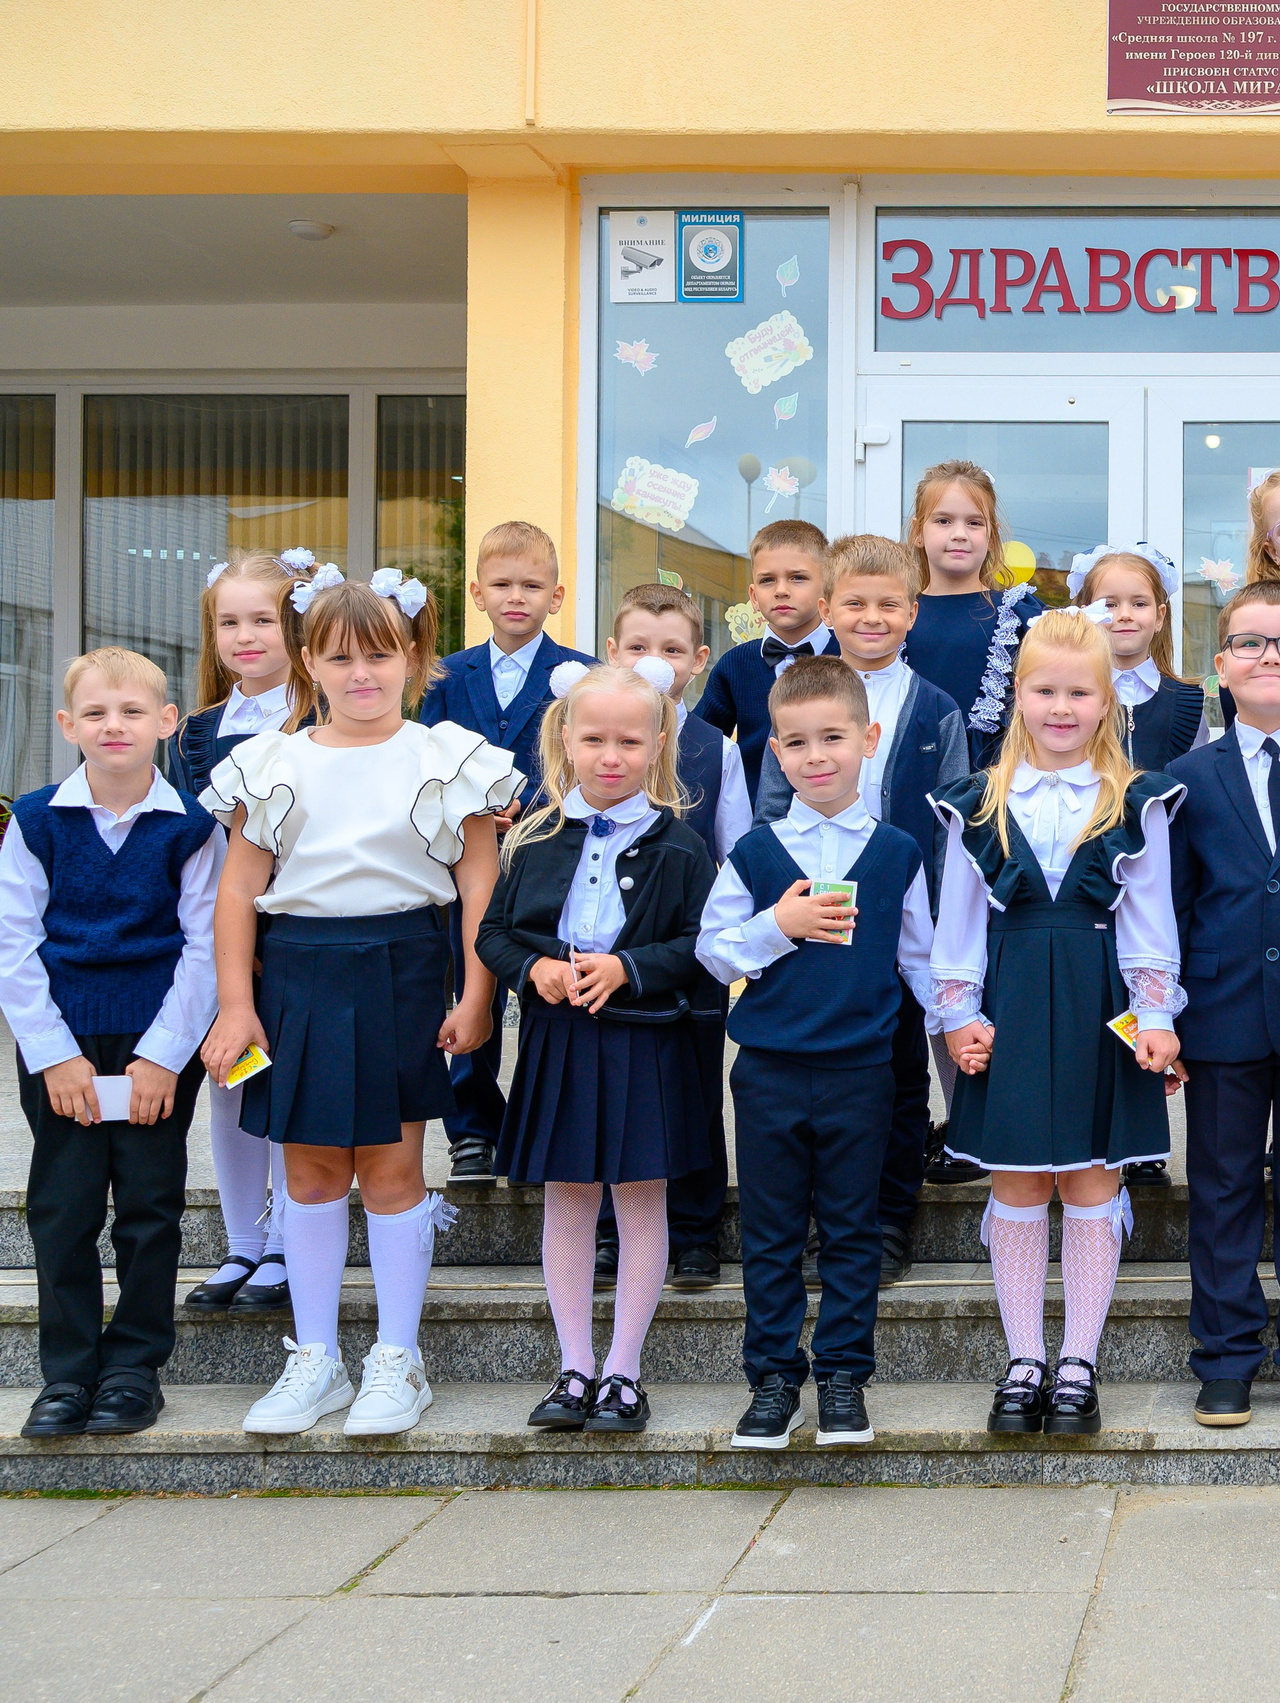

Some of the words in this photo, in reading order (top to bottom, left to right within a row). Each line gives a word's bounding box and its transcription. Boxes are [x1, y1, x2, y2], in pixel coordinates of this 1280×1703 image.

[1137, 16, 1220, 26] УЧРЕЖДЕНИЮ
[1111, 32, 1173, 45] «Средняя
[1177, 35, 1218, 43] школа
[1222, 33, 1236, 43] №
[1240, 32, 1264, 43] 197
[1267, 35, 1277, 43] г.
[1125, 52, 1167, 60] имени
[1170, 50, 1216, 61] Героев
[1219, 50, 1252, 60] 120-й
[1163, 67, 1230, 76] ПРИСВОЕН
[1233, 67, 1279, 76] СТАТУС
[1146, 81, 1228, 94] «ШКОЛА
[681, 214, 740, 224] МИЛИЦИЯ
[747, 325, 774, 345] Буду
[739, 323, 795, 363] отличницей!
[649, 469, 669, 482] уже
[671, 476, 693, 492] жду
[647, 481, 686, 500] осенние
